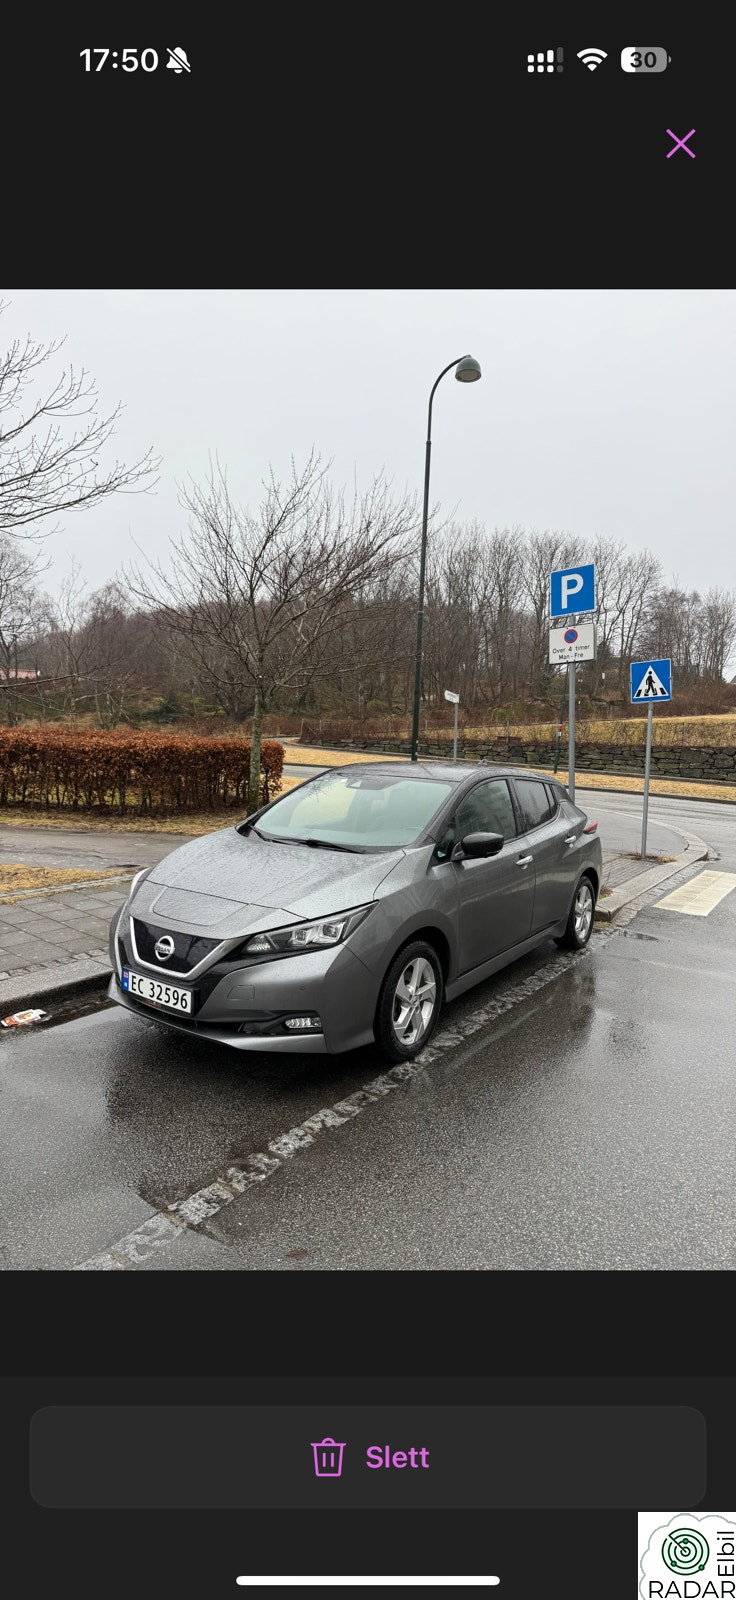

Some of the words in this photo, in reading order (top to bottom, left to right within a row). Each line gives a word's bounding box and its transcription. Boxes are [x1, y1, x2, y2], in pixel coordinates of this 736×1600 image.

[79, 48, 159, 73] 17:50
[630, 51, 657, 69] 30
[561, 573, 584, 610] P
[131, 975, 144, 994] EC
[149, 981, 188, 1009] 32596
[366, 1445, 430, 1469] Slett
